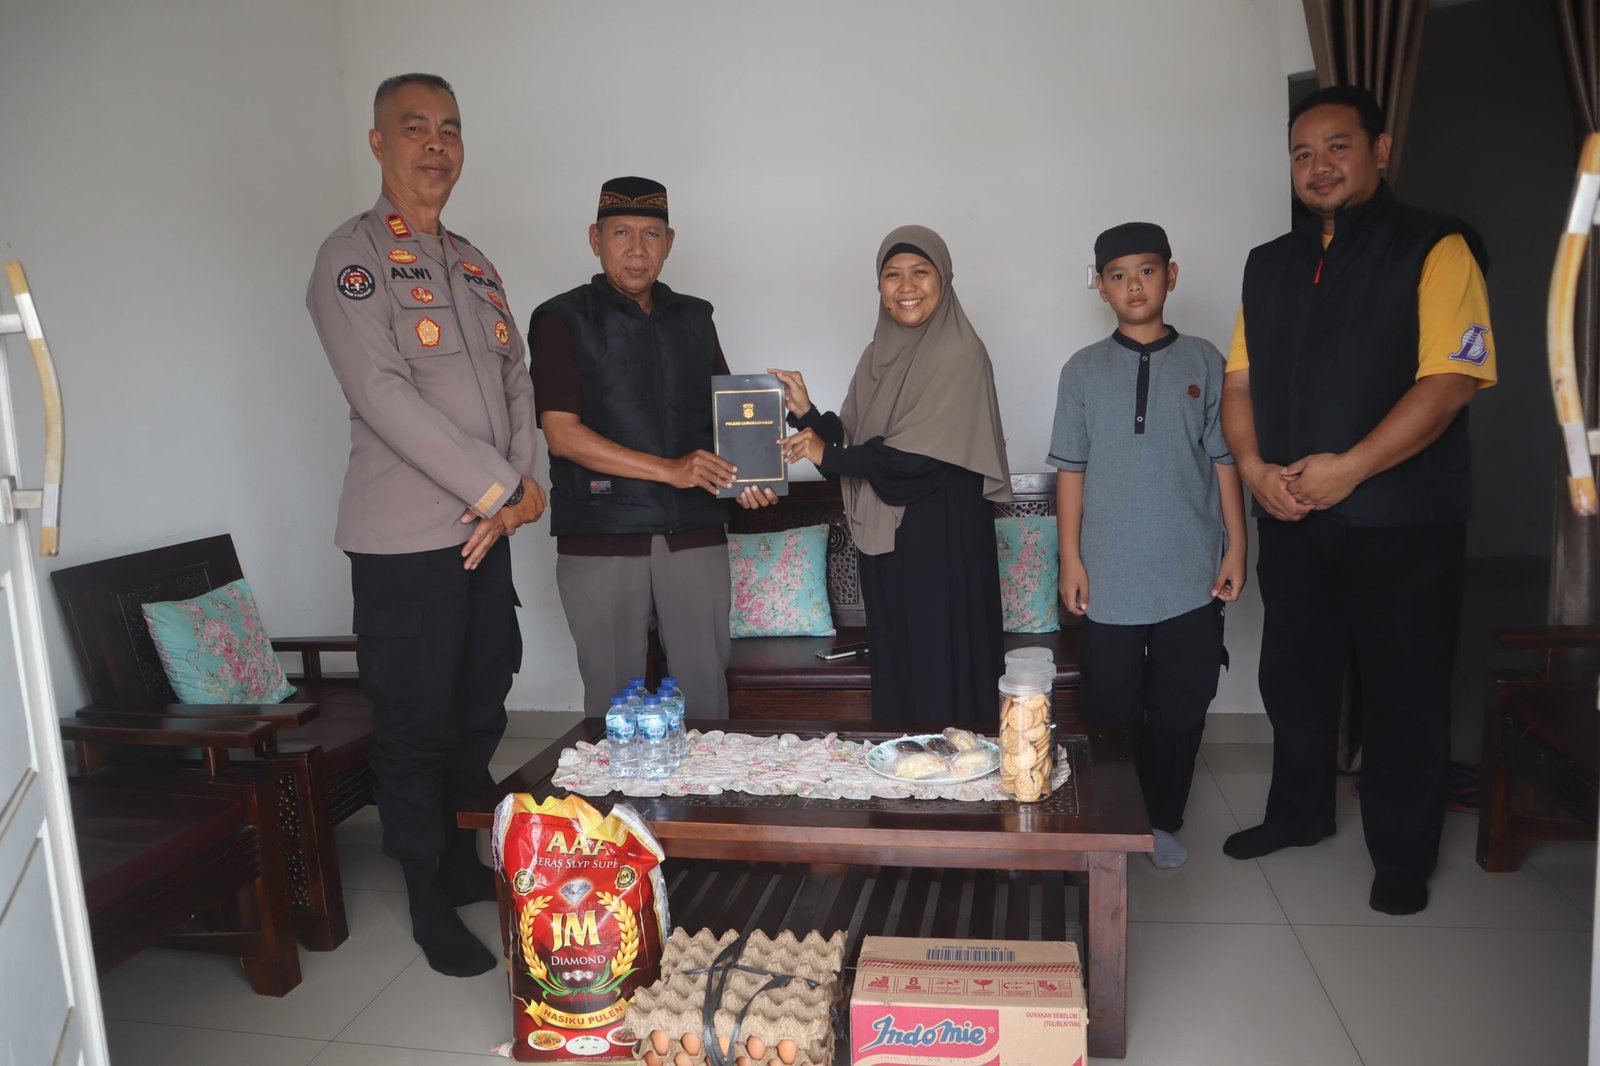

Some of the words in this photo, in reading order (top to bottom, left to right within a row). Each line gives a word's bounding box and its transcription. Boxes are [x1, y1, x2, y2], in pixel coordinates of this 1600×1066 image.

[391, 267, 432, 280] ALWI
[546, 831, 610, 856] AAA
[566, 858, 590, 870] SLYP
[551, 955, 606, 966] DIAMOND
[543, 1008, 585, 1025] NASIKU
[588, 1005, 624, 1024] PULEN
